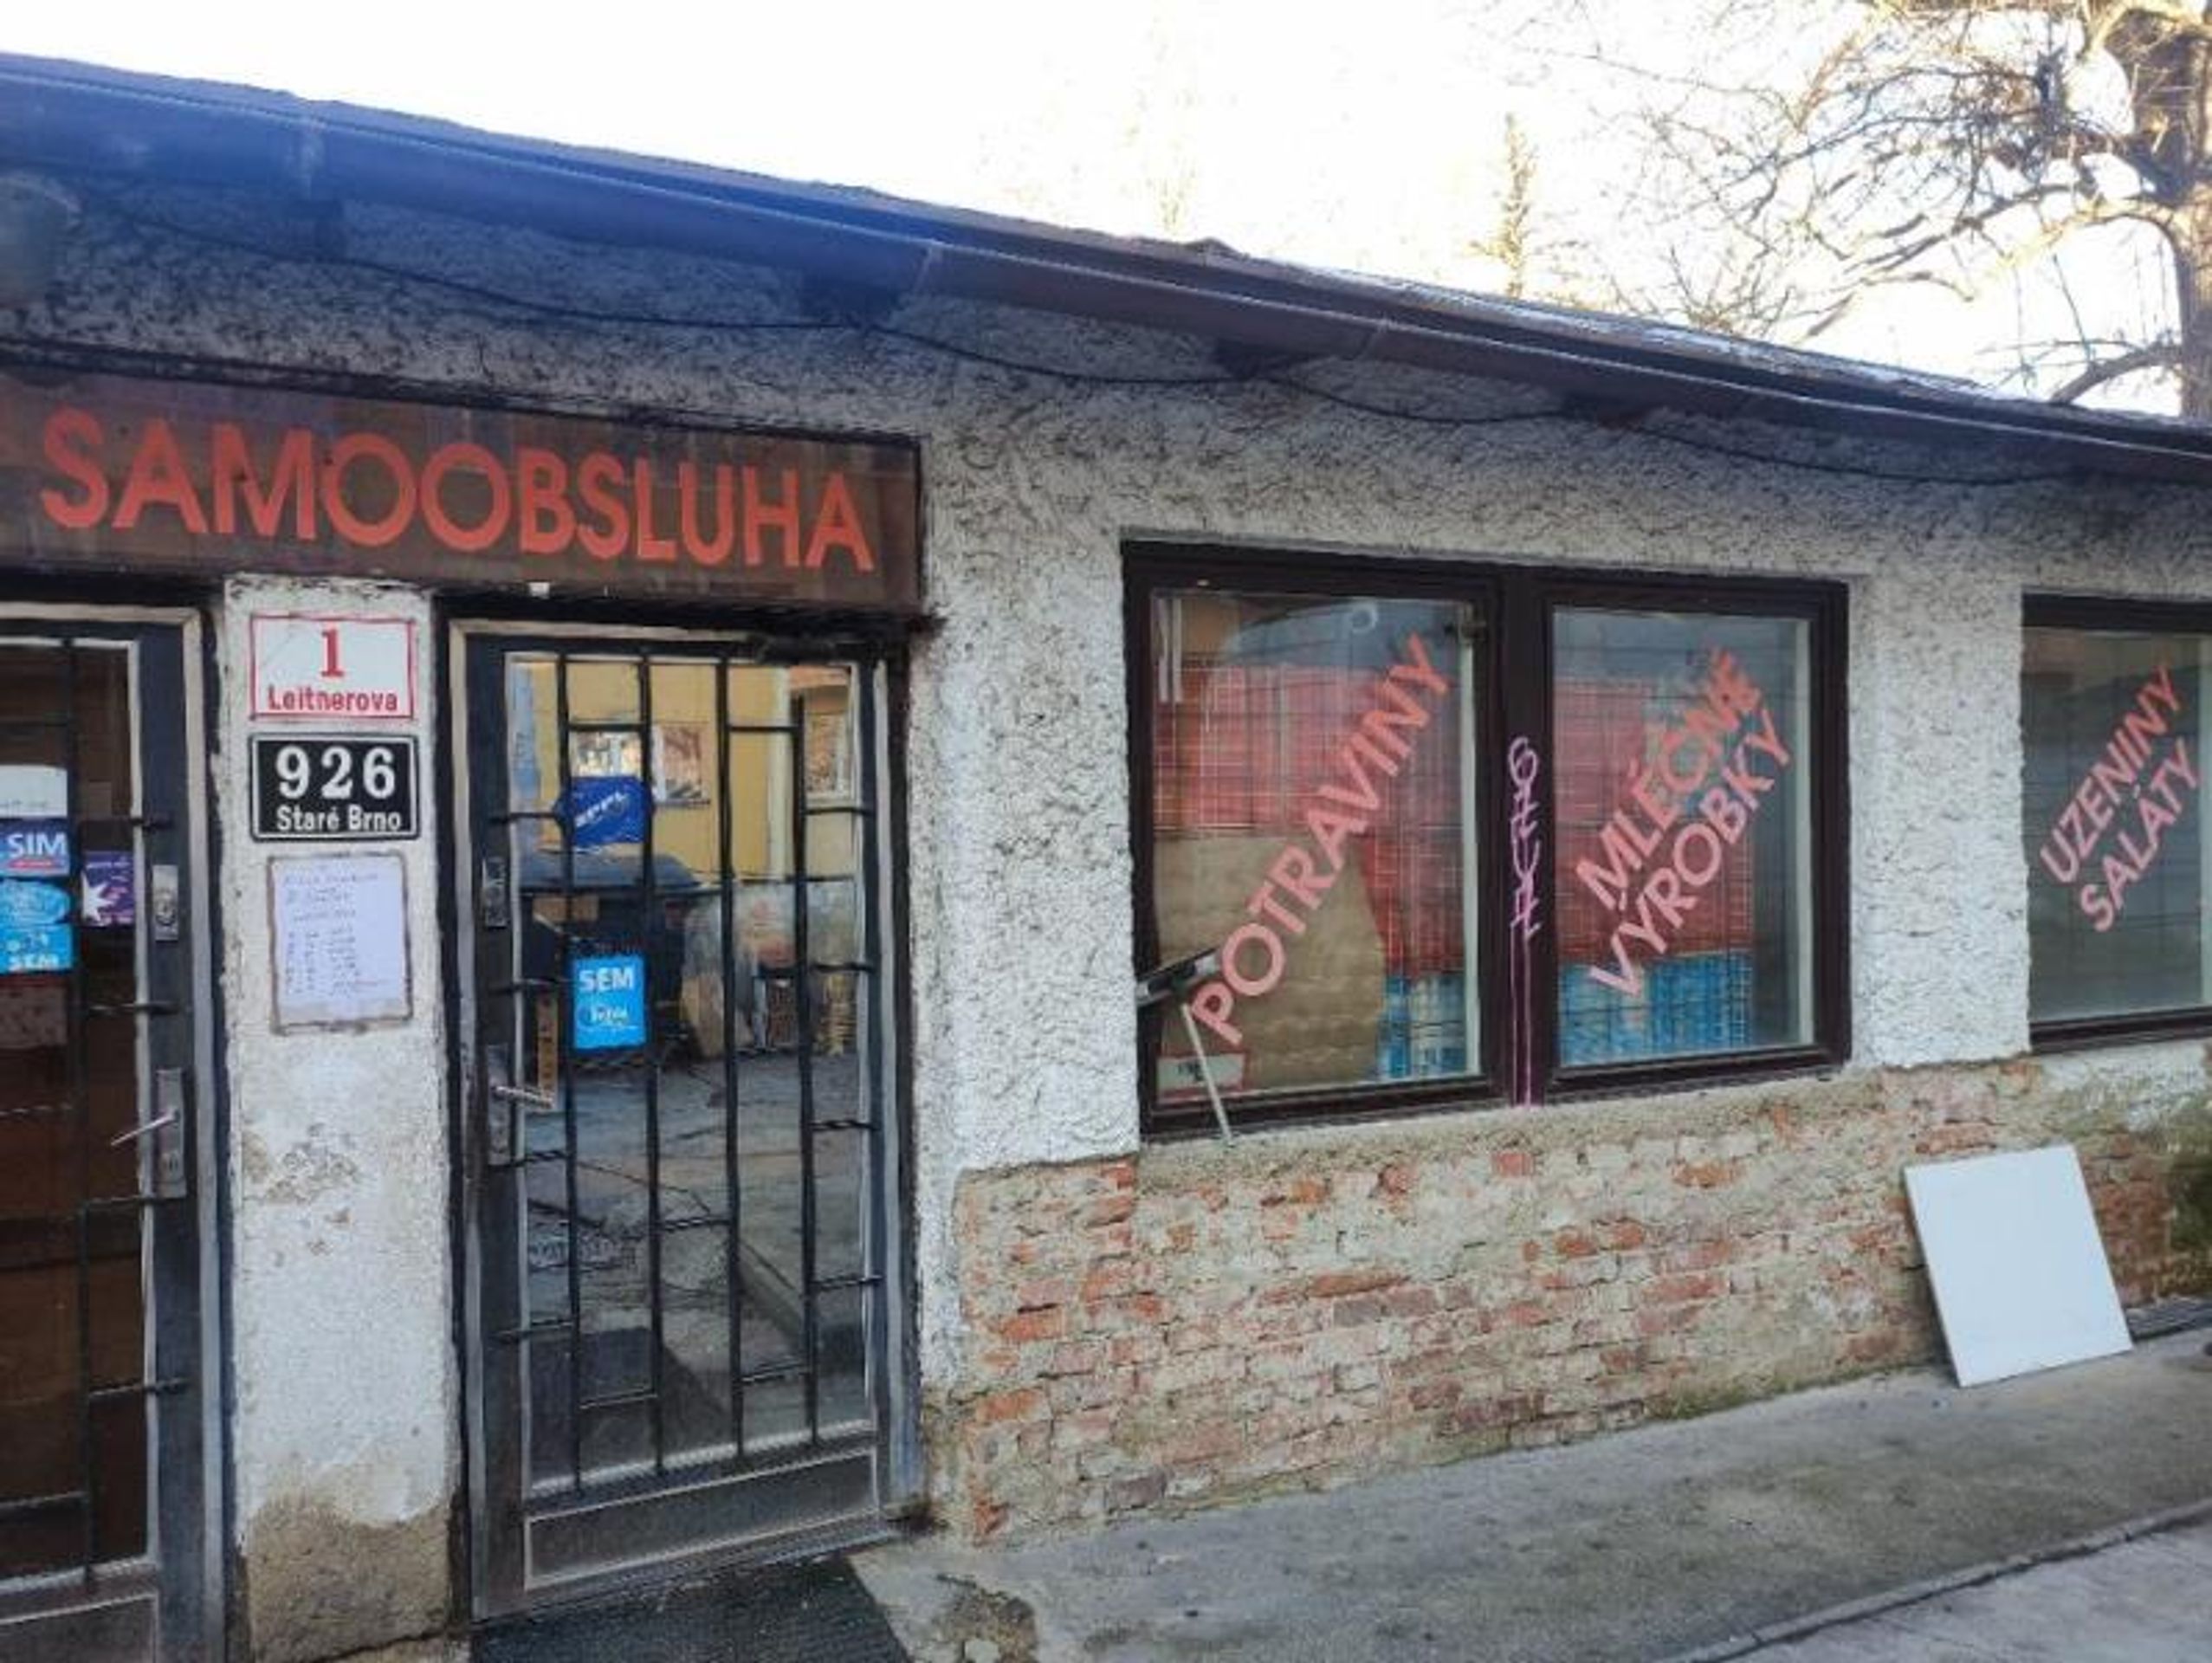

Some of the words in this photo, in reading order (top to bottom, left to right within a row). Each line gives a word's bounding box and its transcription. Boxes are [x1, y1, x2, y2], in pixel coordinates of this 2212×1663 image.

[40, 408, 874, 572] SAMOOBSLUHA
[320, 628, 345, 678] 1
[268, 684, 398, 712] Leitnerova
[275, 745, 397, 799] 926
[2040, 663, 2182, 883] UZENINY
[6, 832, 69, 858] SIM
[276, 806, 340, 832] Staré
[348, 804, 402, 832] Brno
[1190, 631, 1451, 1045] POTRAVINY
[2080, 737, 2198, 933] SALÁTY
[1588, 709, 1790, 998] VÝROBKY
[578, 967, 634, 994] SEM
